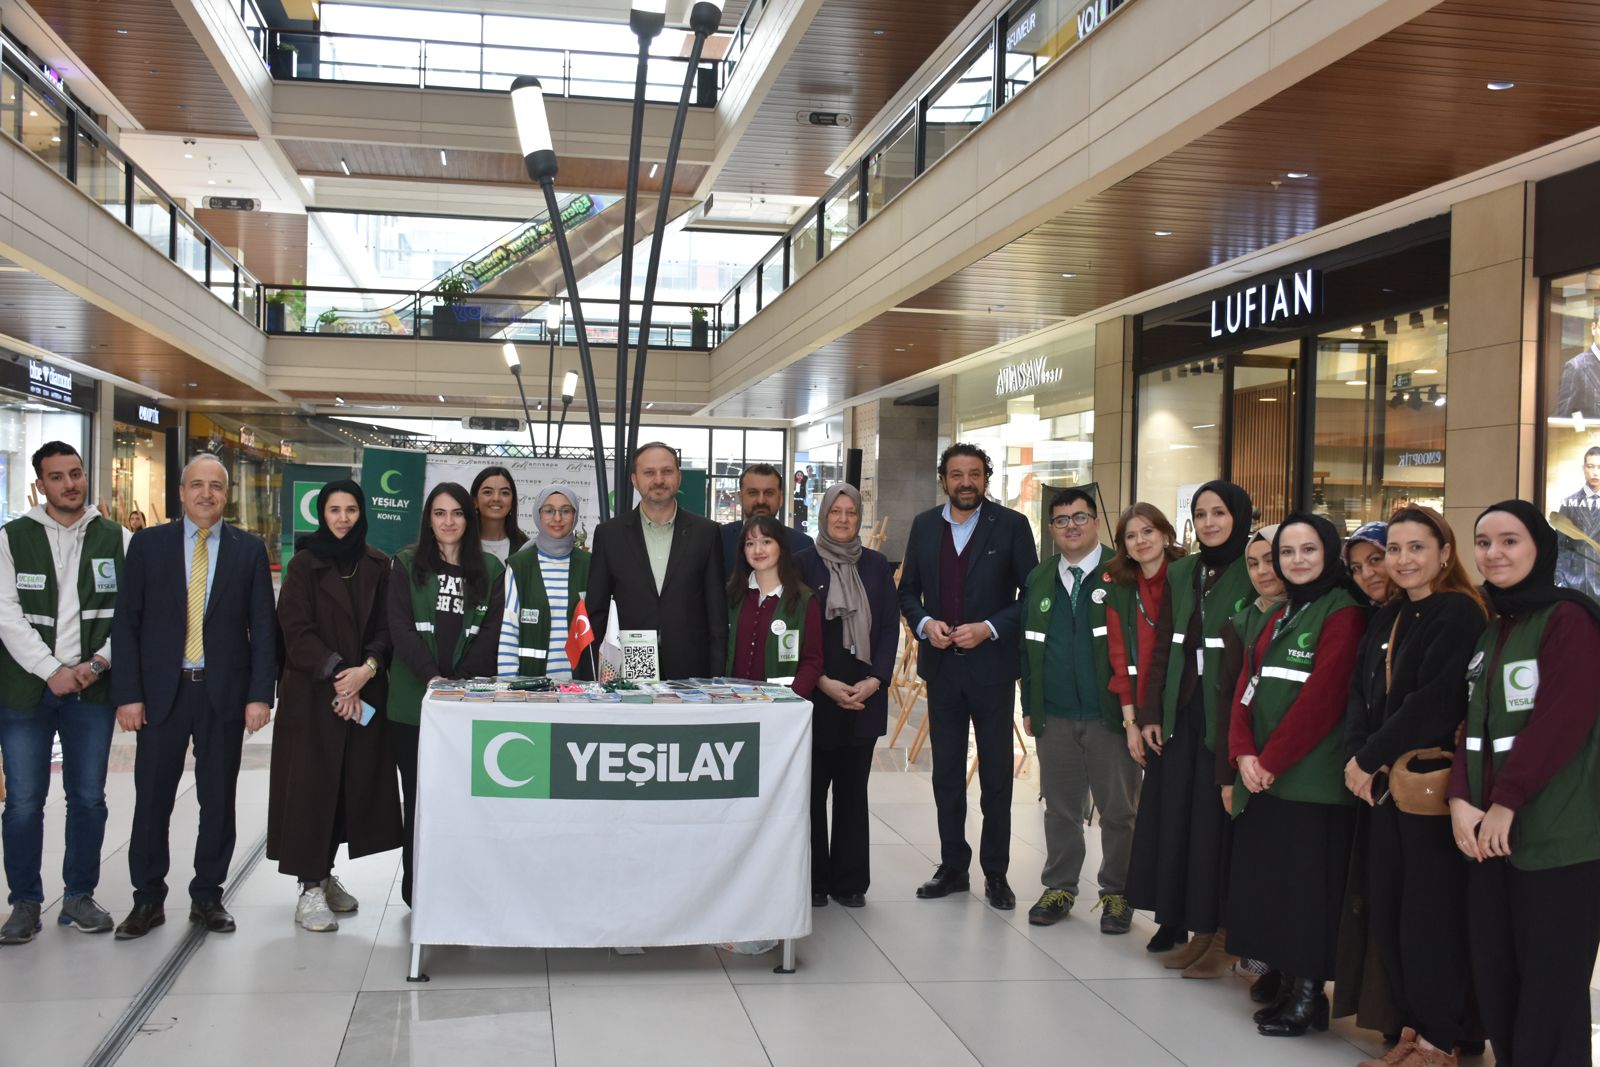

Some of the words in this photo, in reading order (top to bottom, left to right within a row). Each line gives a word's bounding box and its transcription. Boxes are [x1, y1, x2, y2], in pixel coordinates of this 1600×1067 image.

[1006, 12, 1036, 50] RFUMEUR
[1211, 269, 1312, 338] LUFIAN
[377, 513, 402, 522] KONYA
[566, 740, 746, 788] YEŞİLAY
